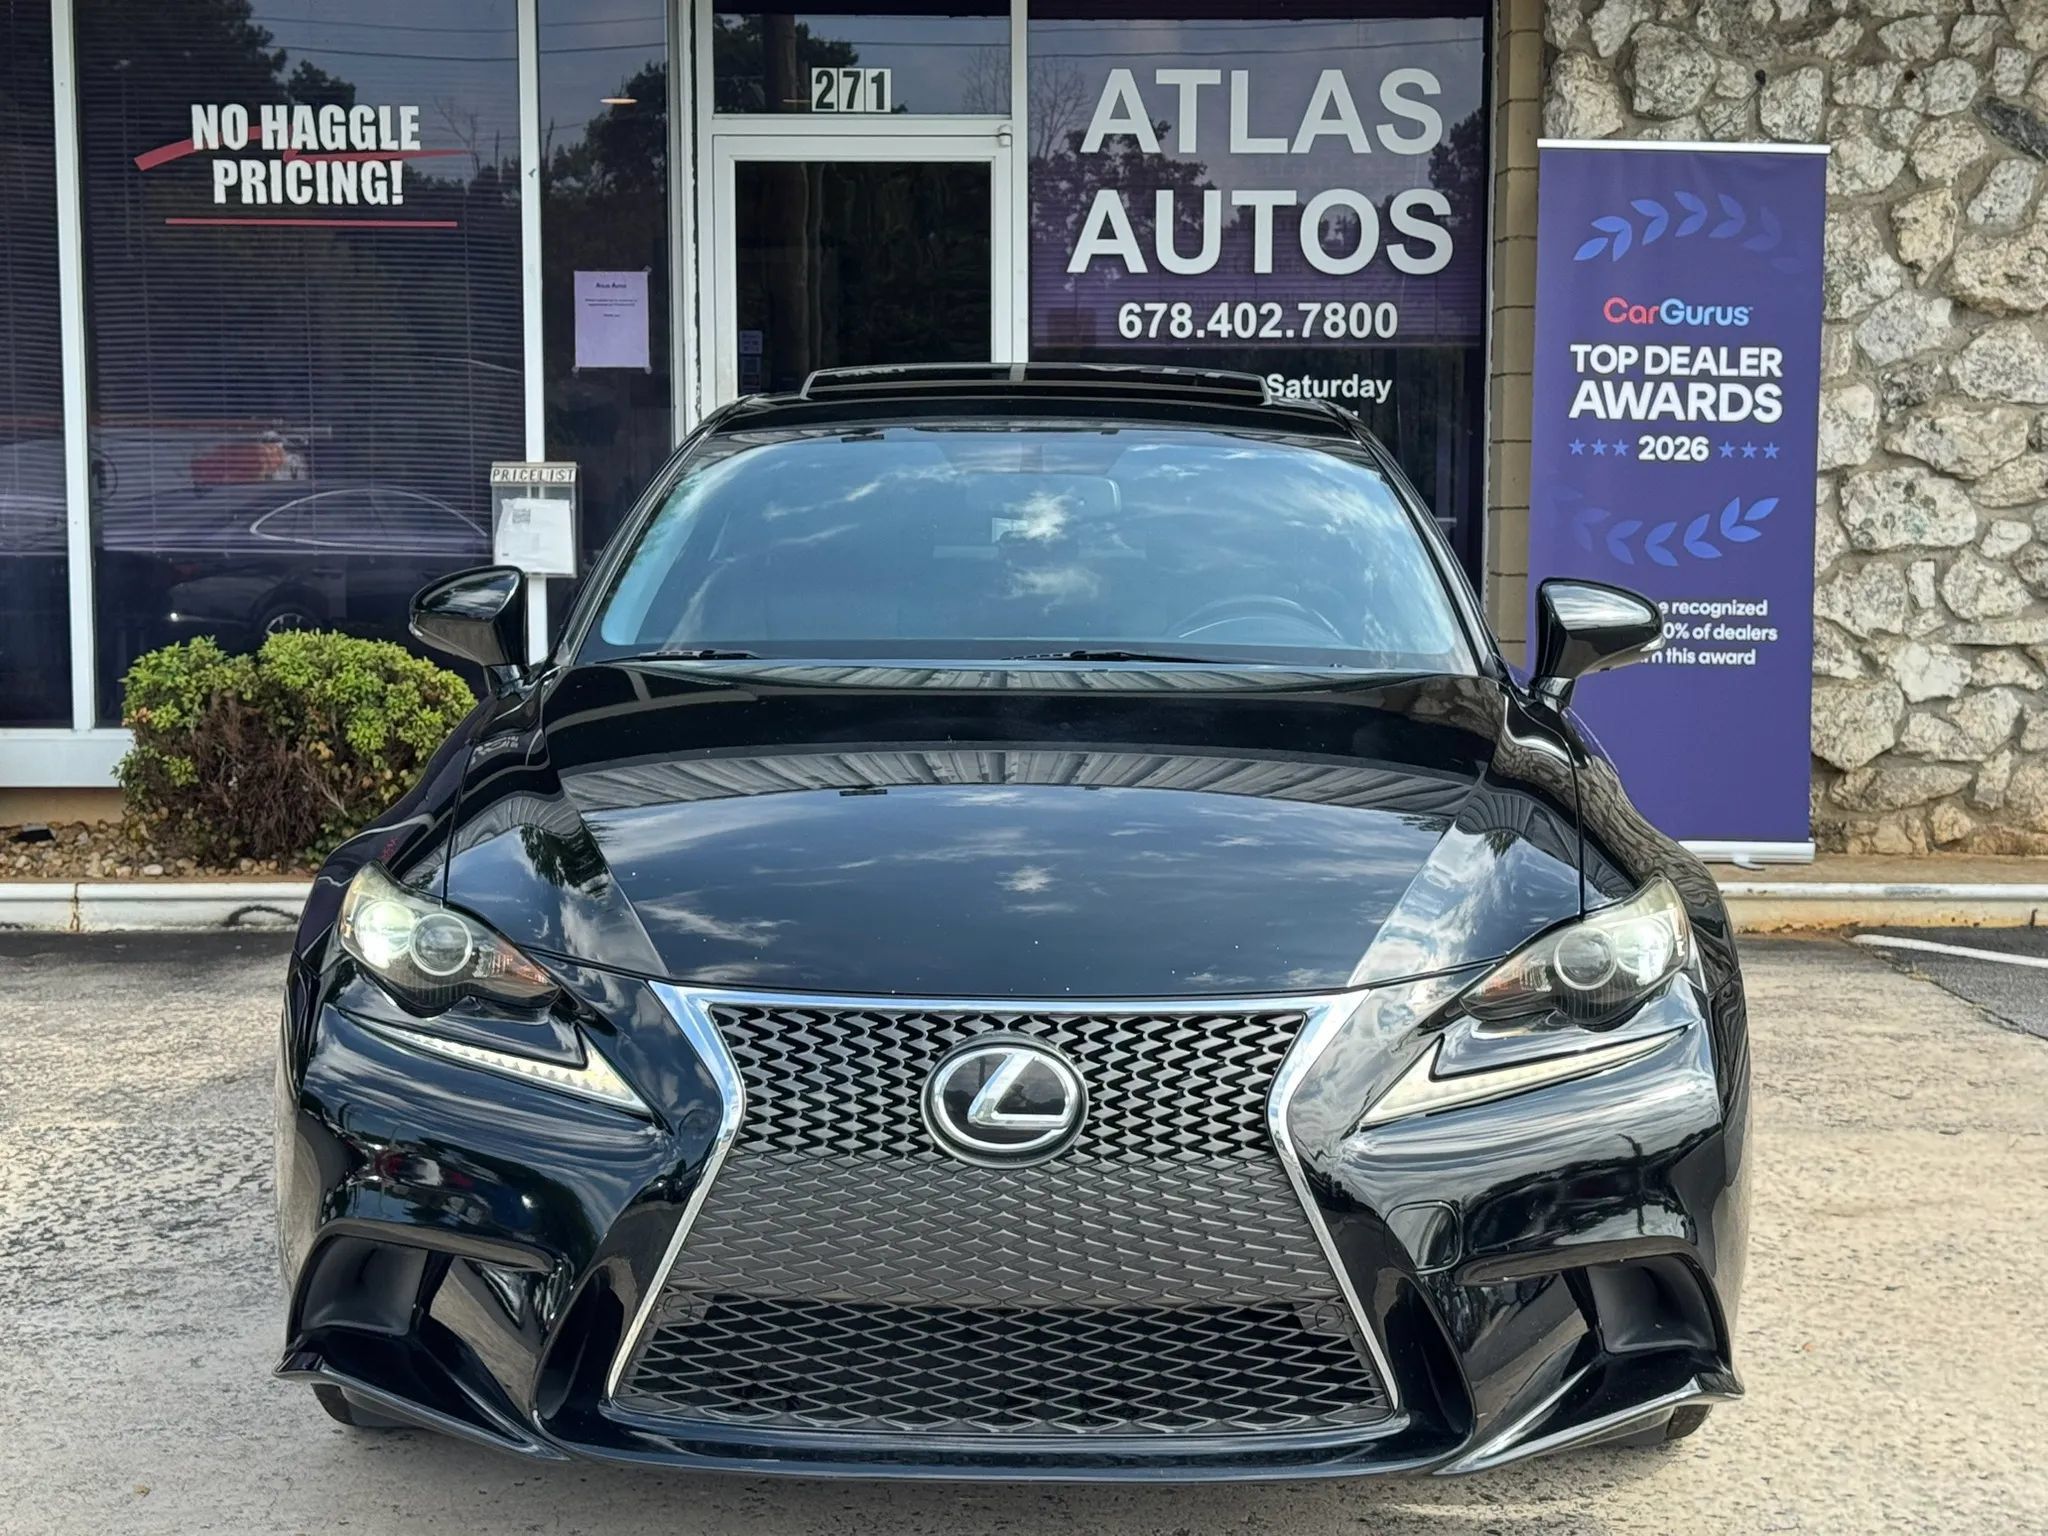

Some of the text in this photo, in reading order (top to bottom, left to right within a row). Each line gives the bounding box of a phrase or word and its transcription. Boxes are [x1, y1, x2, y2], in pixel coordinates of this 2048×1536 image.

[814, 69, 886, 111] 271
[190, 103, 422, 151] NO HAGGLE
[1079, 67, 1443, 155] ATLAS
[212, 159, 404, 205] PRICING!
[1066, 188, 1454, 276] AUTOS
[1117, 301, 1399, 339] 678.402.7800
[1602, 296, 1751, 327] CarGurus
[1569, 344, 1784, 378] TOP DEALER
[1266, 372, 1393, 404] Saturday
[1568, 379, 1784, 424] AWARDS
[1637, 434, 1710, 462] 2026
[1671, 599, 1769, 619] recognized
[1692, 623, 1713, 640] of
[1713, 624, 1779, 642] dealers
[1666, 647, 1696, 665] this
[1698, 648, 1757, 666] award
